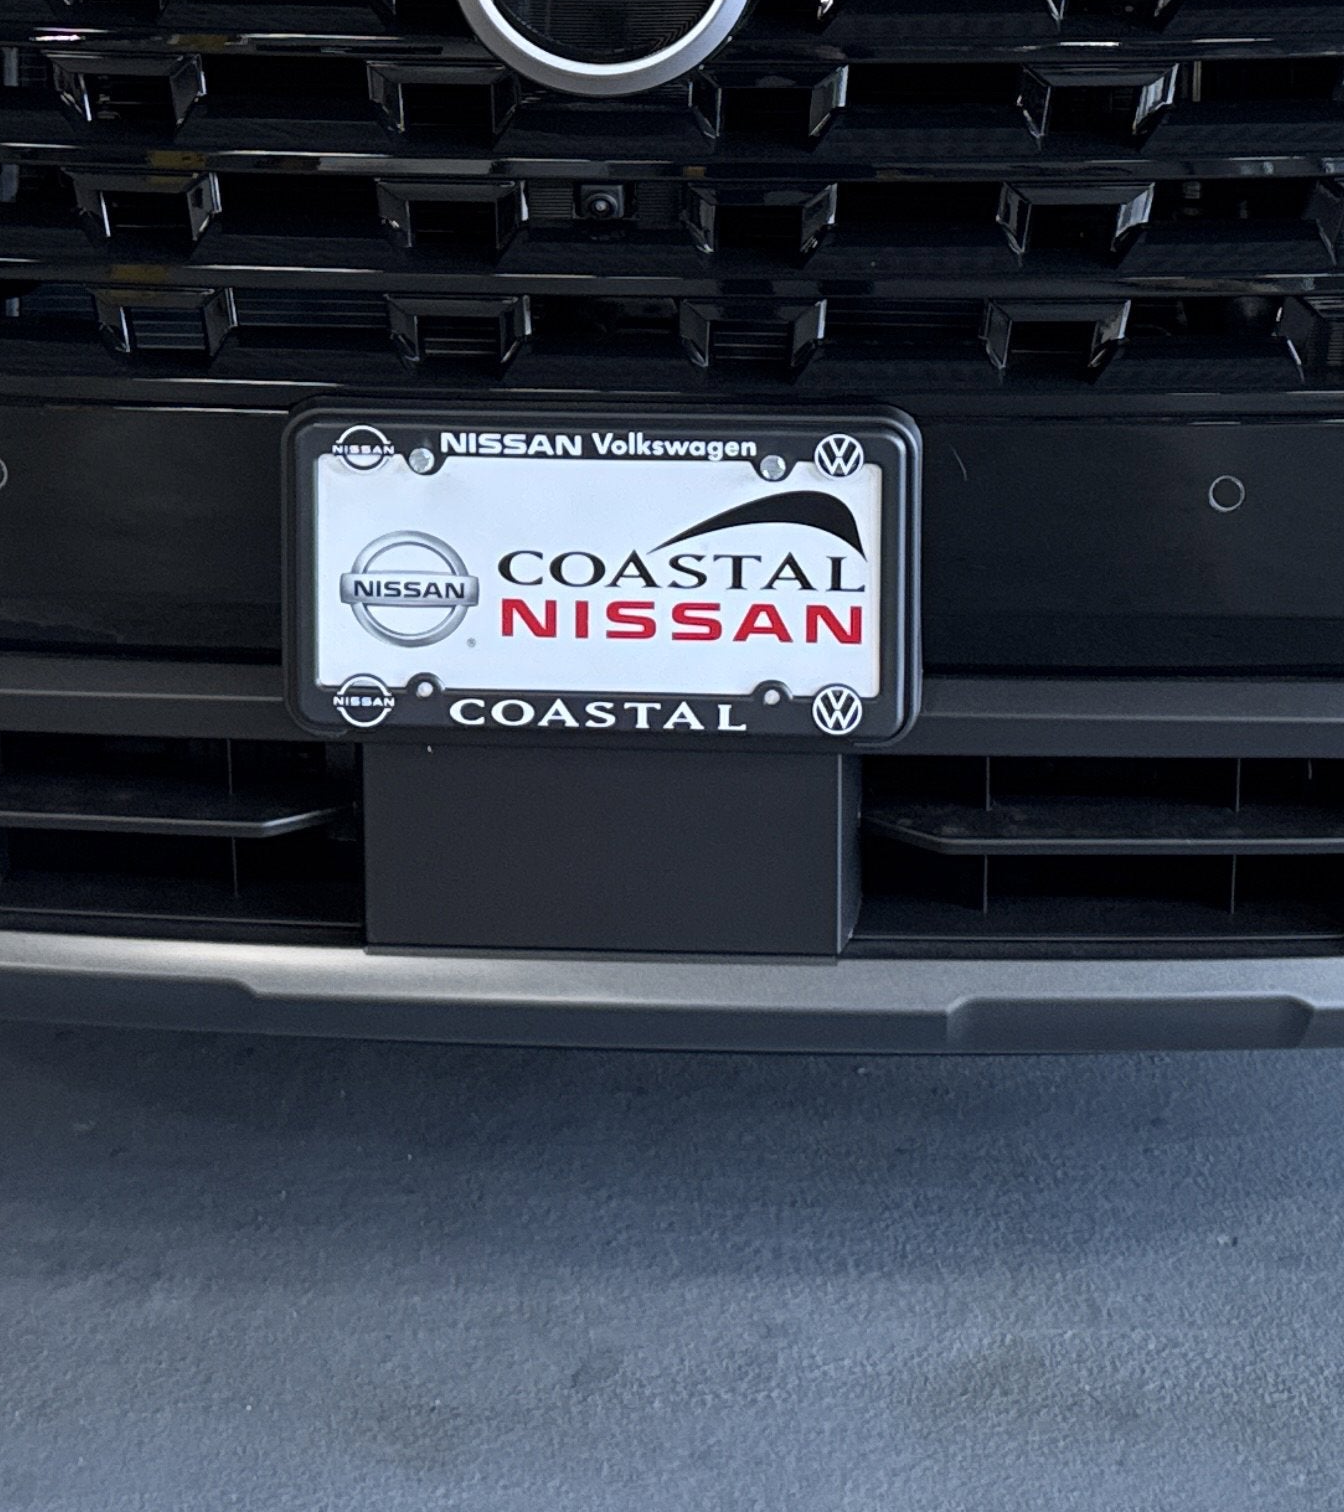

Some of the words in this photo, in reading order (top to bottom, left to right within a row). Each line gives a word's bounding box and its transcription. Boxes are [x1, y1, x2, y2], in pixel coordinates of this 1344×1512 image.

[332, 444, 395, 455] NISSAN
[440, 431, 583, 457] NISSAN
[592, 432, 757, 462] Volkswagen
[497, 549, 867, 594] COASTAL
[353, 579, 465, 600] NISSAN
[501, 598, 863, 646] NISSAN
[333, 696, 395, 707] NISSAN
[448, 698, 748, 732] COASTAL
